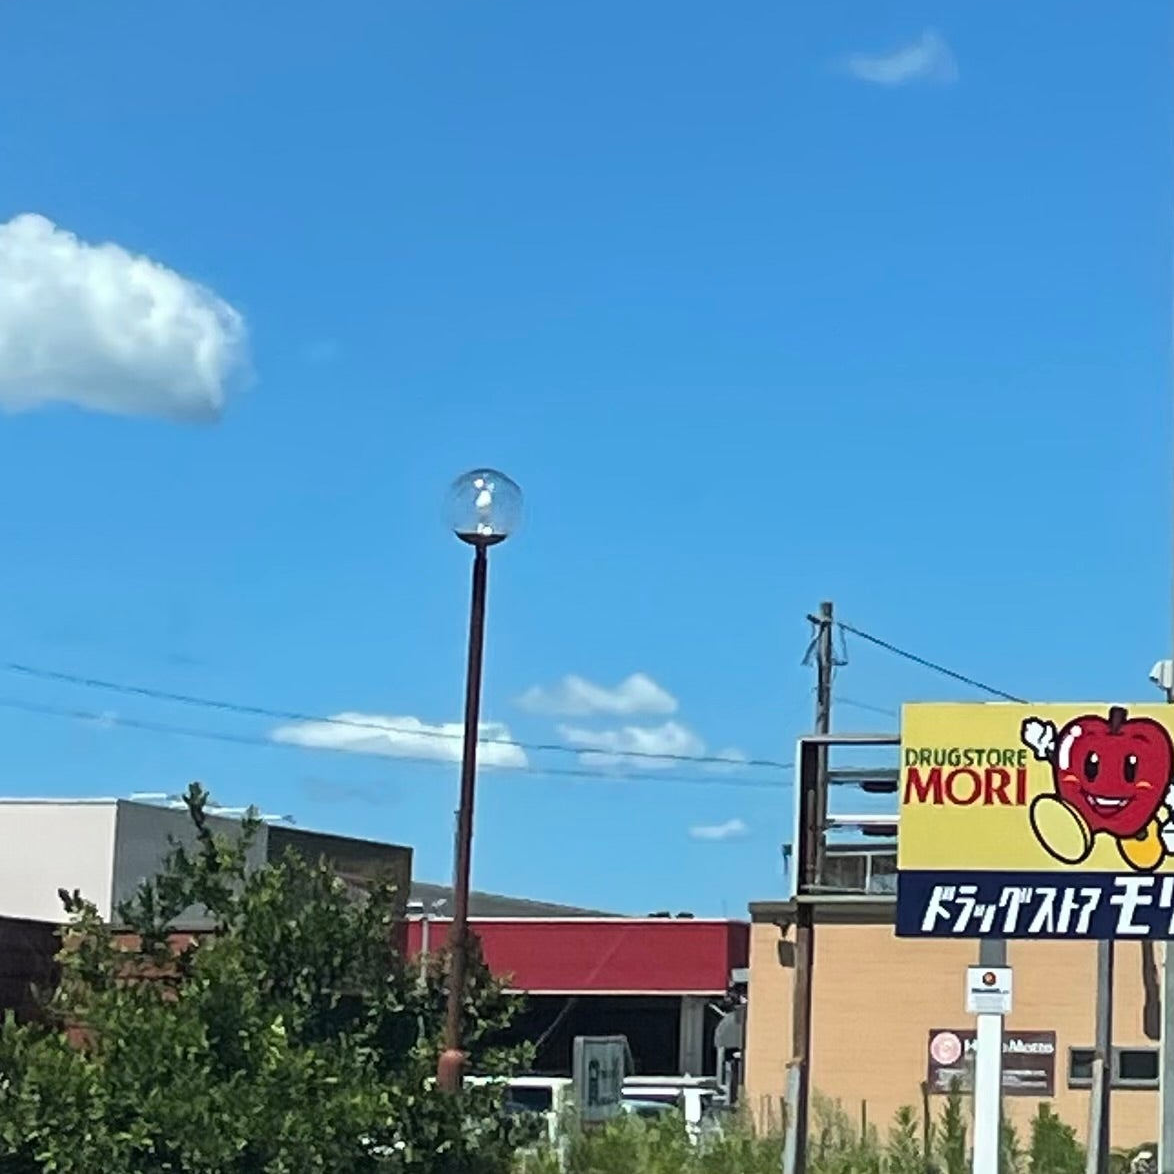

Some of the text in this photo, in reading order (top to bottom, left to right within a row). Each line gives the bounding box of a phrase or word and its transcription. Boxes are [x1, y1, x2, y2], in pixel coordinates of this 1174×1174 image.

[905, 747, 1027, 767] DRUGSTORE
[902, 768, 1027, 806] MORI
[921, 885, 1102, 933] ドラッグストア
